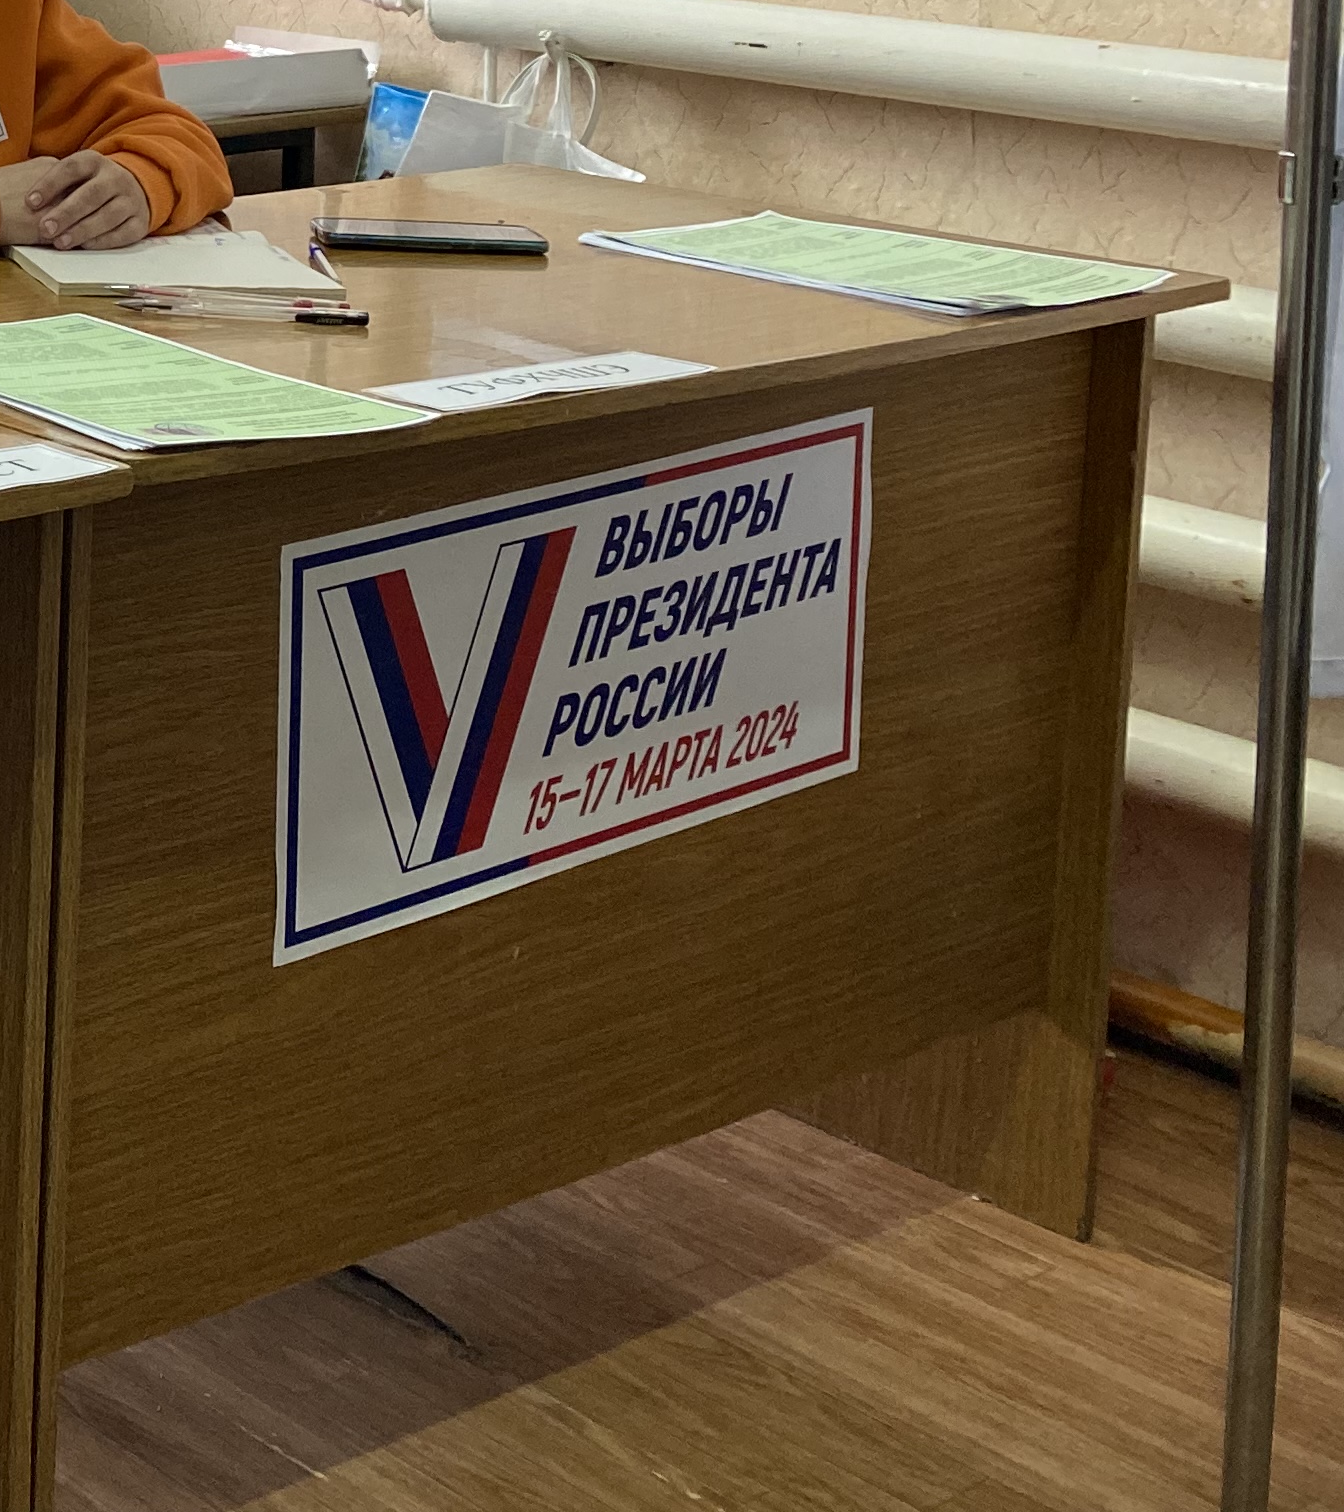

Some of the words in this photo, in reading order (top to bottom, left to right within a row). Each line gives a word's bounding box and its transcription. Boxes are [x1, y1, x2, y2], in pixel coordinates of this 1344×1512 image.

[594, 473, 793, 578] ВЫБОРЫ
[568, 538, 841, 668] ПРЕЗИДЕНТА
[542, 648, 727, 757] РОССИИ
[615, 725, 721, 805] МАРТА
[725, 700, 799, 769] 2024
